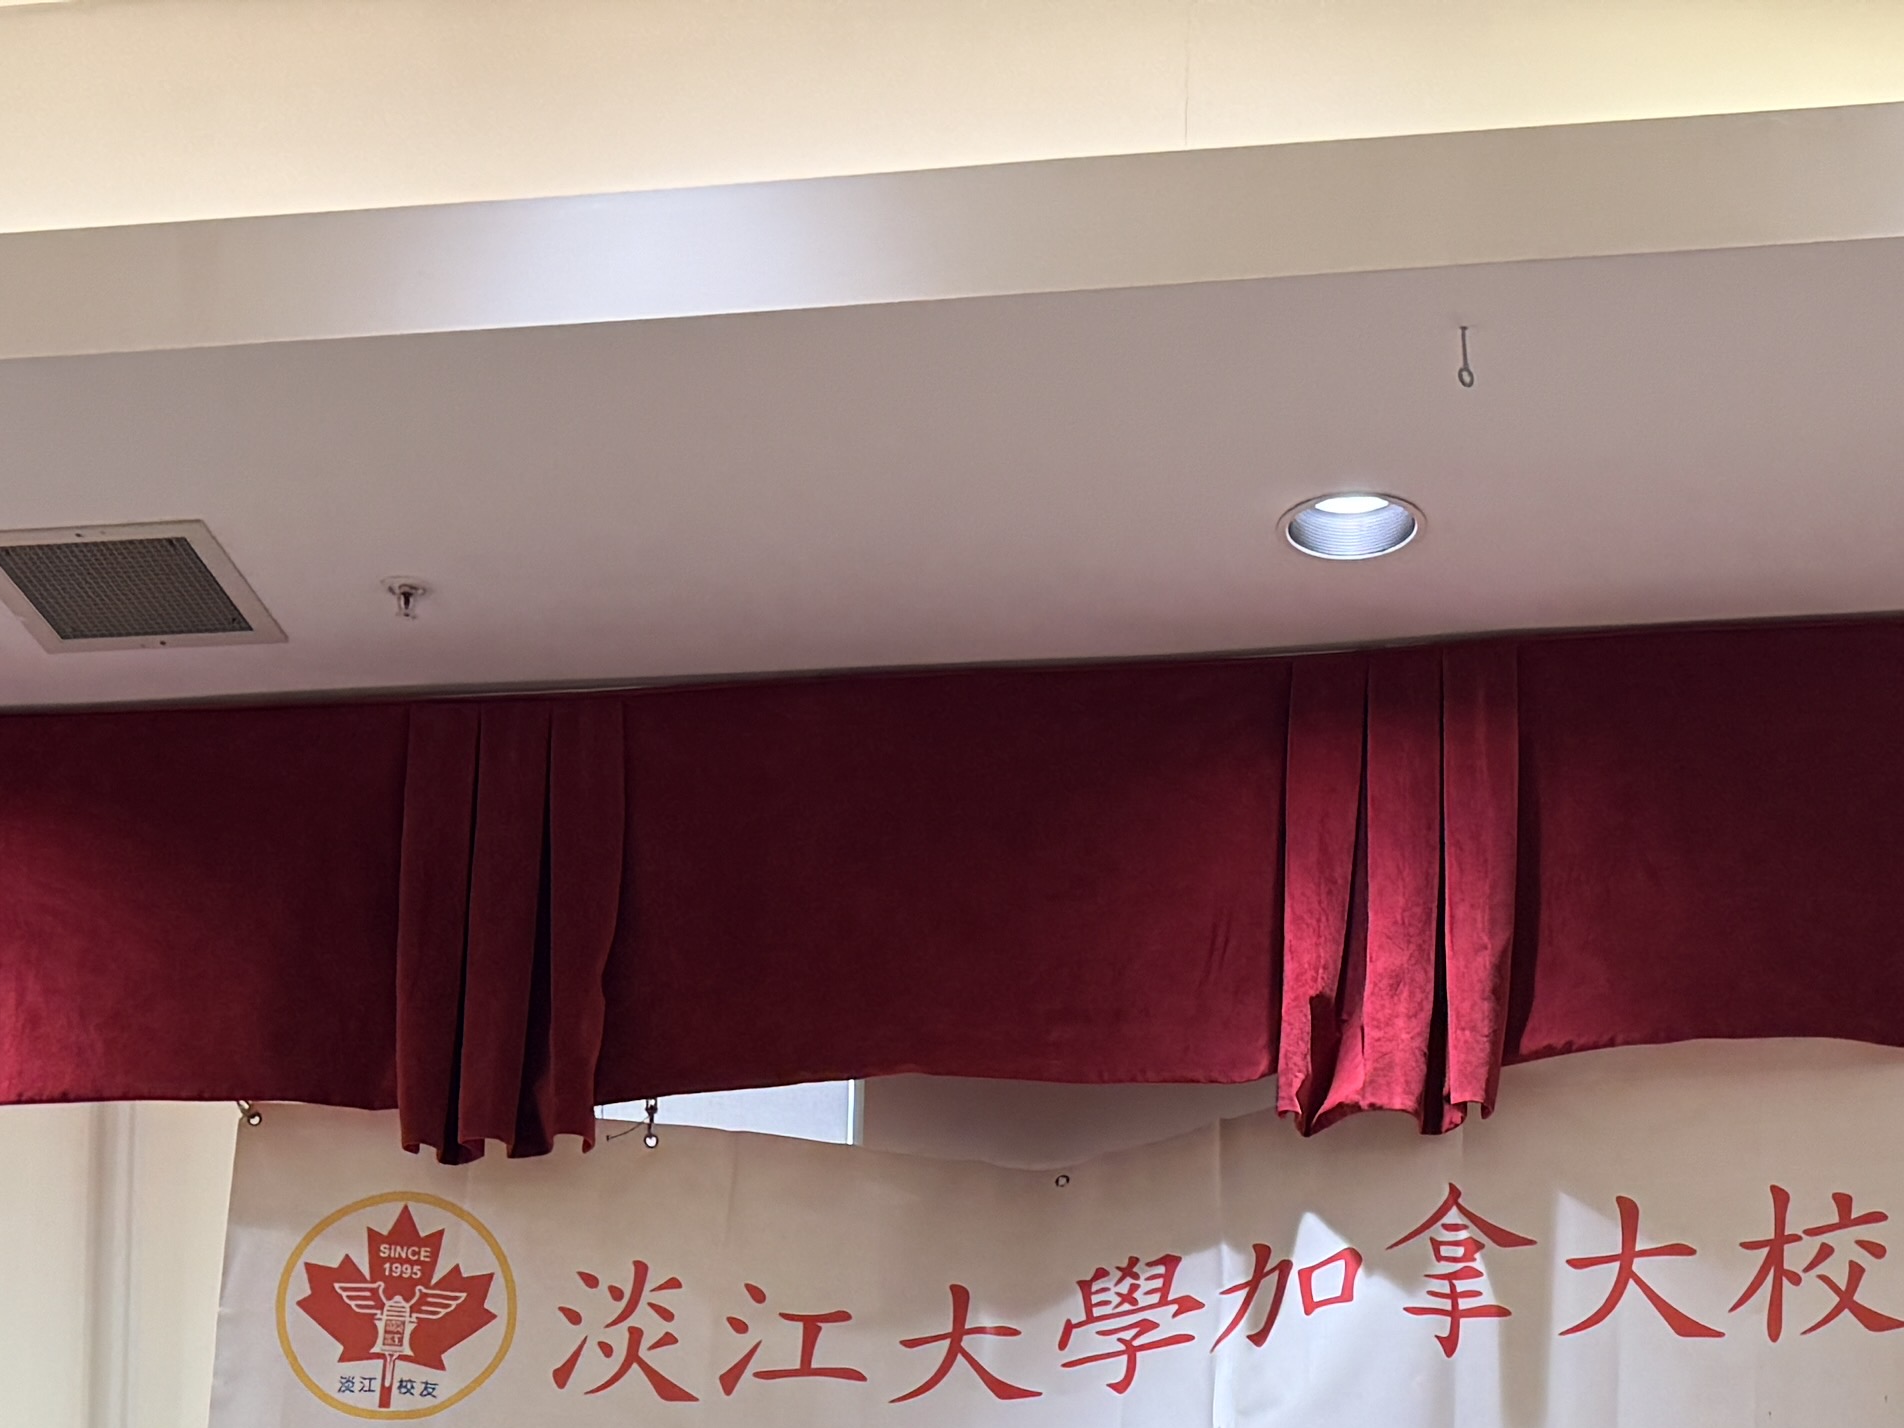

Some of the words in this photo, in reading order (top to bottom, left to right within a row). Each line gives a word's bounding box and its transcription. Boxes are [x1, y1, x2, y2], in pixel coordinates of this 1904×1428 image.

[379, 1244, 431, 1262] SINCE
[383, 1263, 421, 1279] 1995
[337, 1375, 376, 1393] 淡江
[397, 1377, 438, 1398] 校友
